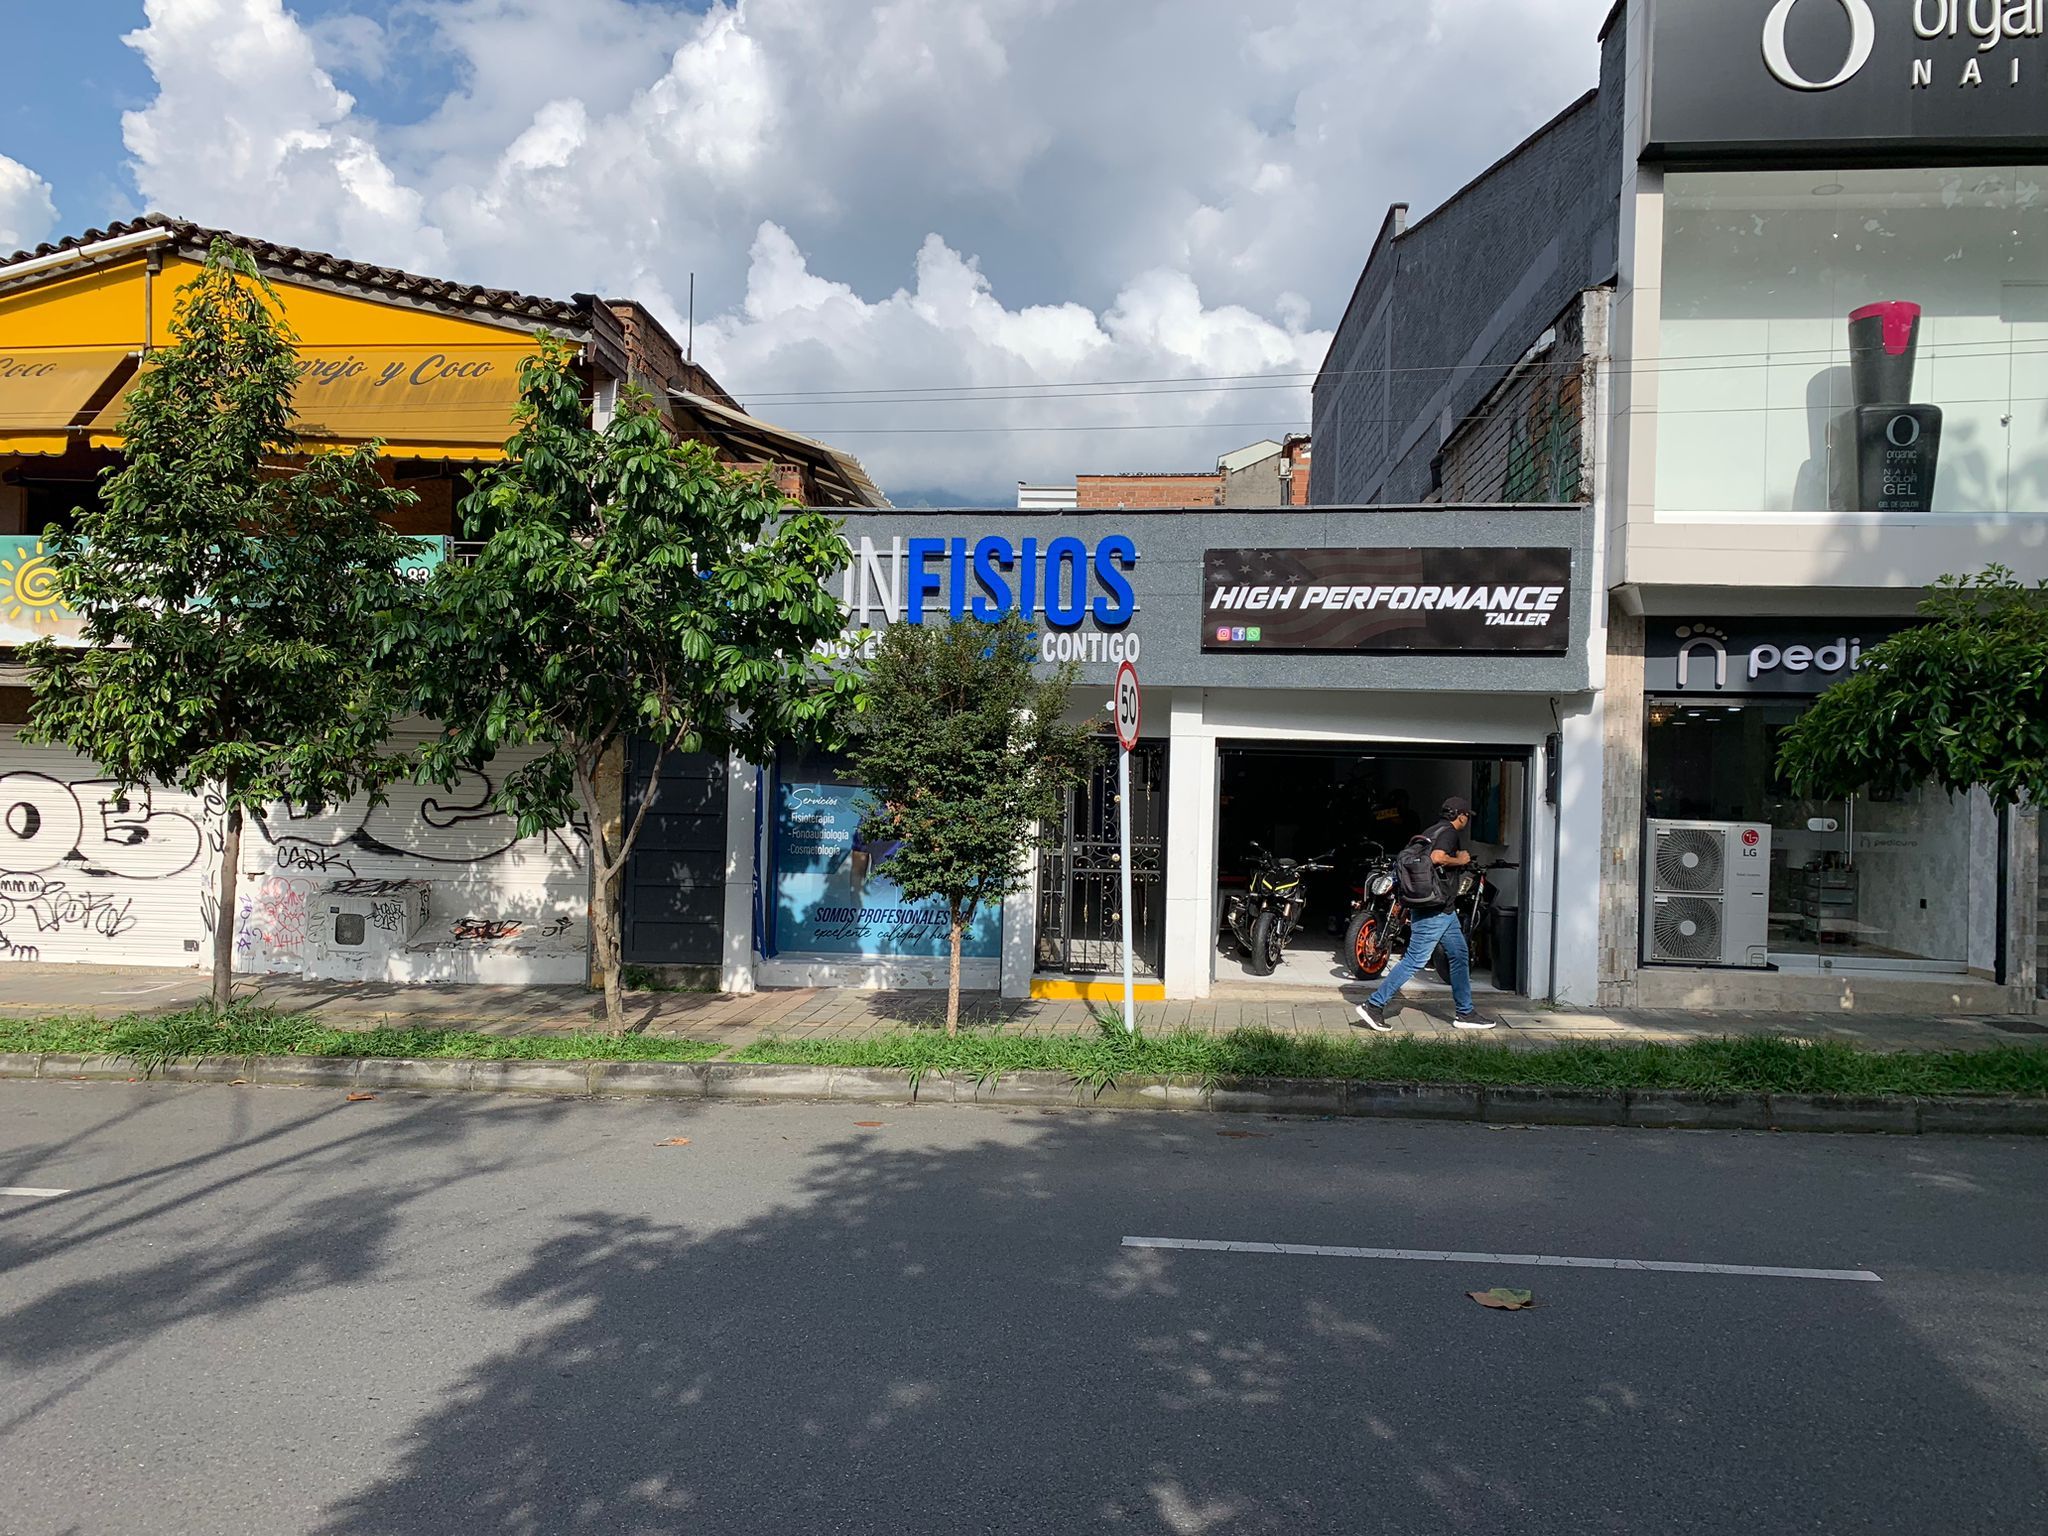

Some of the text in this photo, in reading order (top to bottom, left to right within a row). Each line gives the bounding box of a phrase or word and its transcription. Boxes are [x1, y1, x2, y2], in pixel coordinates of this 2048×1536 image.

[1912, 58, 2020, 86] NAI
[295, 353, 495, 387] arejo y Coco
[1883, 475, 1918, 483] COLOR
[1883, 483, 1917, 495] GEL
[1209, 586, 1565, 611] HIGH PERFORMANCE
[1484, 612, 1551, 626] TALLER
[1042, 632, 1141, 663] CONTIGO
[1121, 684, 1137, 725] 50
[788, 787, 838, 811] Servicios
[1743, 848, 1757, 857] LG
[814, 907, 857, 923] SOMOS
[857, 908, 950, 926] PROFESIONALES
[814, 920, 872, 942] excelente
[876, 922, 927, 946] calidad
